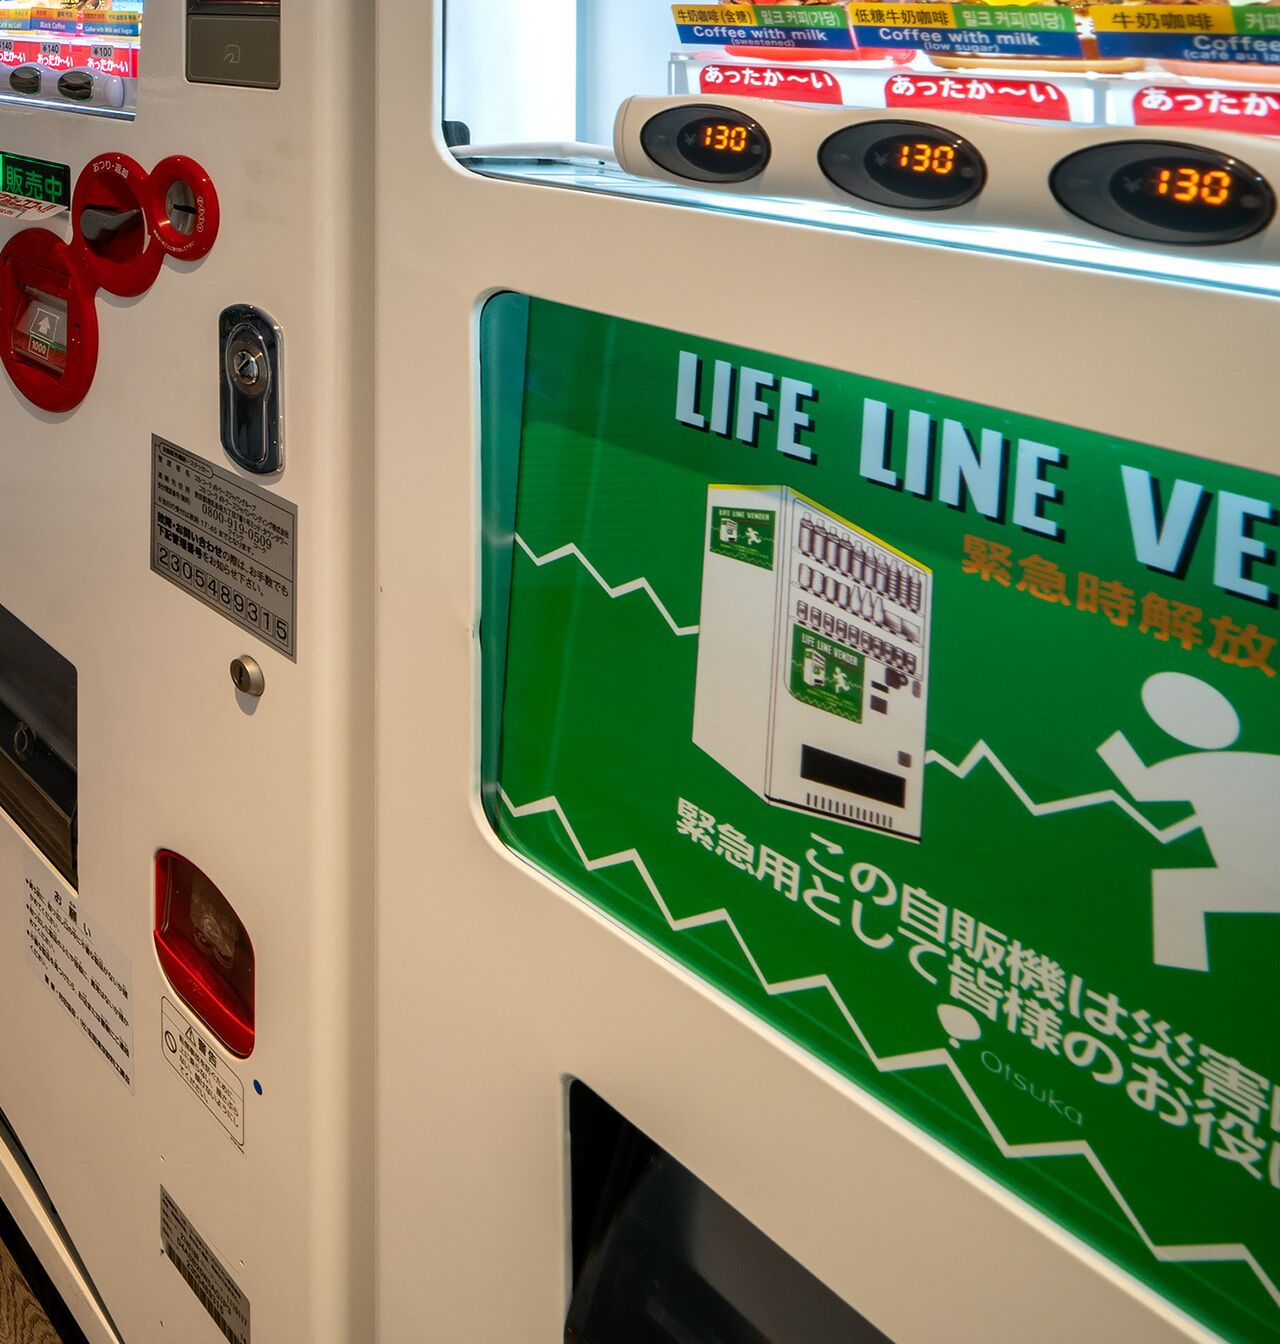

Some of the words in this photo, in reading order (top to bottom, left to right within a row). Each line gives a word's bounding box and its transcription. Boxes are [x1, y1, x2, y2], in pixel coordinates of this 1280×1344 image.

[678, 9, 719, 23] 牛奶咖啡
[721, 9, 752, 24] (含糖)
[761, 10, 783, 24] 밀크
[855, 8, 948, 25] 低糖牛奶咖啡
[963, 12, 992, 28] 밀크
[1112, 11, 1213, 31] 牛奶咖啡
[694, 25, 746, 39] Coffee
[751, 27, 784, 40] with
[792, 29, 827, 42] milk
[731, 37, 795, 48] (sweetened)
[879, 28, 936, 43] Coffee
[942, 30, 989, 44] with
[996, 32, 1040, 46] milk
[42, 44, 60, 54] ¥140
[93, 47, 113, 57] ¥100
[924, 42, 950, 52] (low
[954, 43, 1000, 54] sugar)
[1238, 52, 1258, 61] au
[703, 125, 747, 153] 130
[900, 144, 954, 174] 130
[6, 165, 63, 204] 販売中
[1155, 169, 1231, 205] 130
[30, 338, 47, 356] 1000
[676, 350, 816, 461] LIFE
[859, 397, 1063, 534] LINE
[202, 504, 272, 549] 0800-919-0509
[159, 547, 288, 641] 2305489315
[962, 532, 1279, 679] 緊急時解放
[807, 832, 1280, 1136] この自販機は災害
[980, 1049, 1085, 1127] Otsuka
